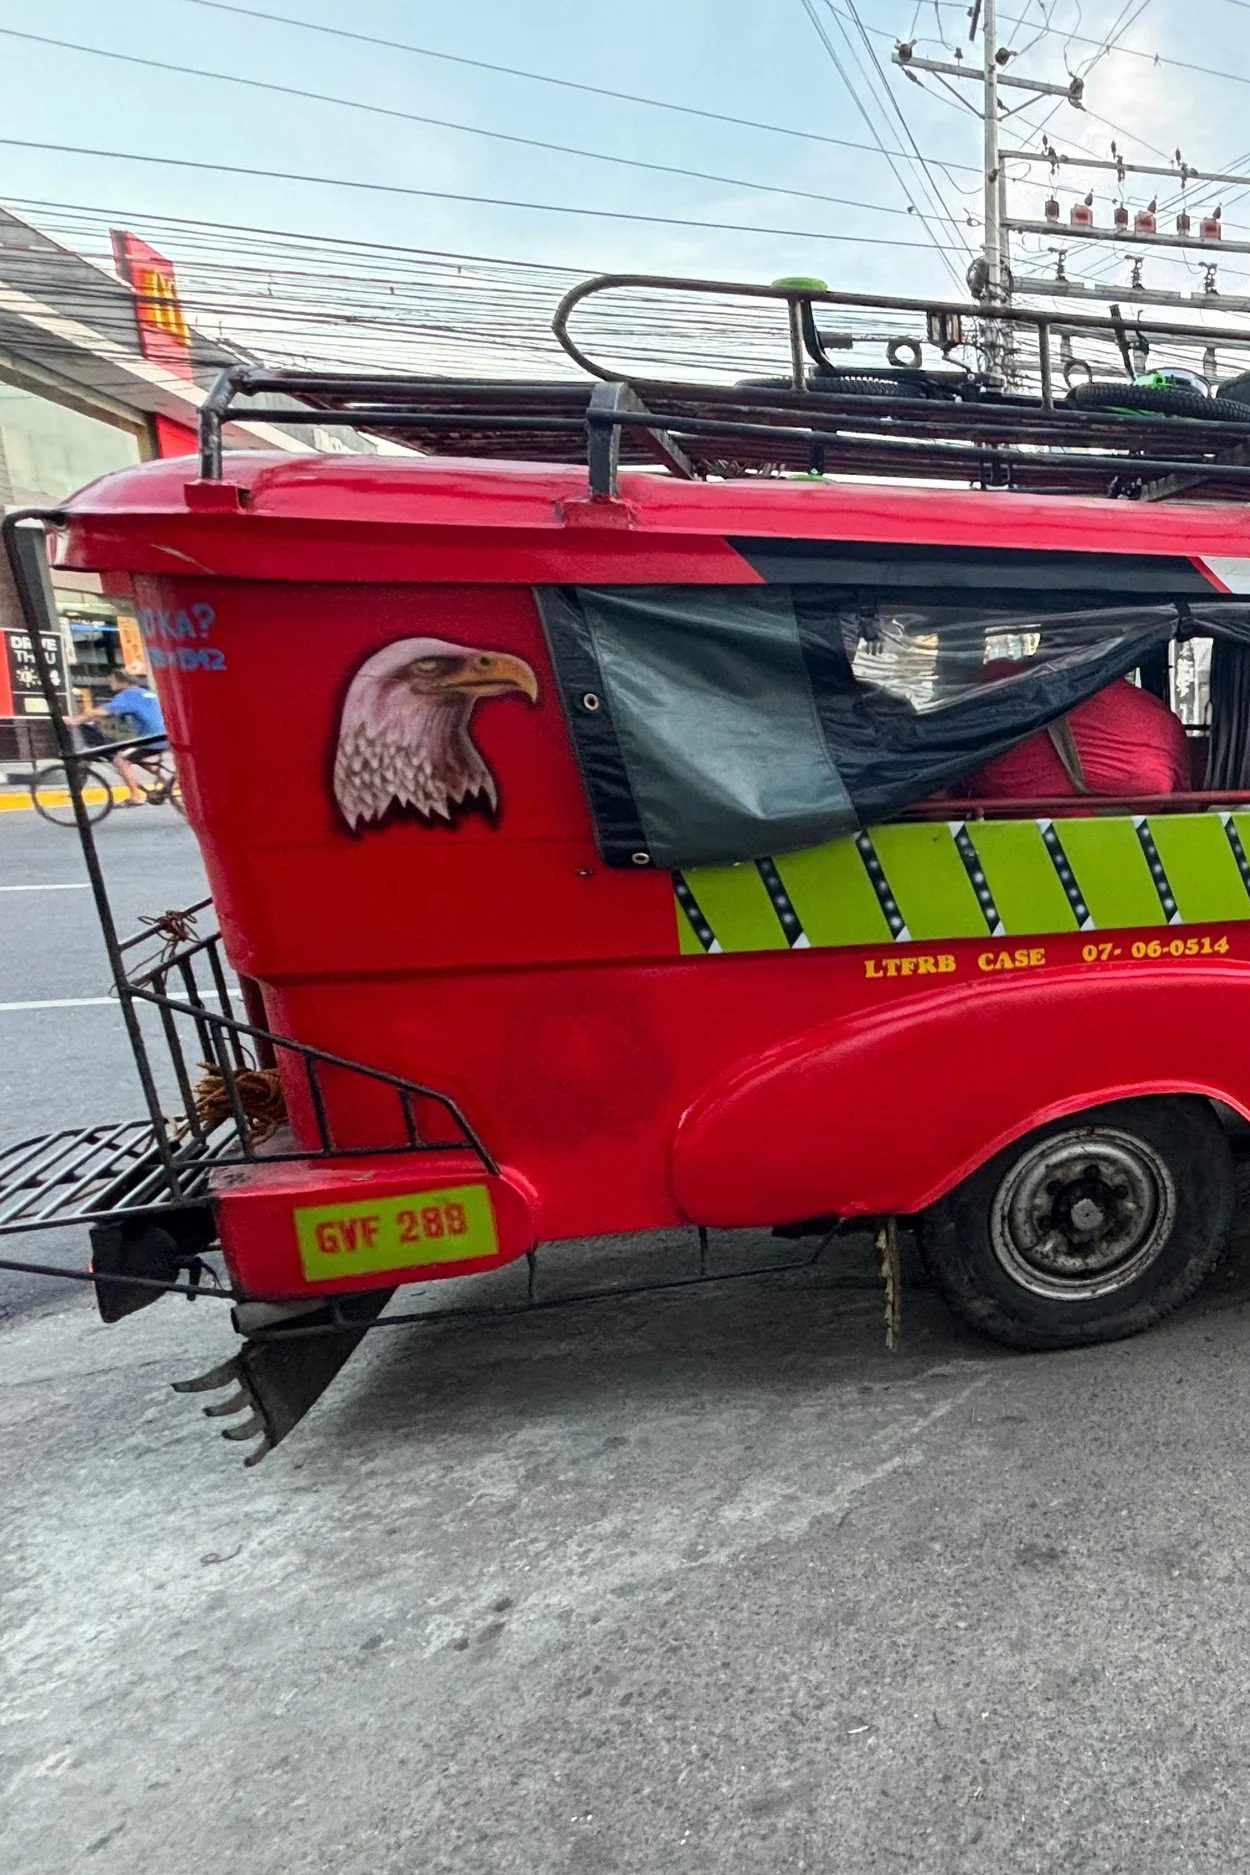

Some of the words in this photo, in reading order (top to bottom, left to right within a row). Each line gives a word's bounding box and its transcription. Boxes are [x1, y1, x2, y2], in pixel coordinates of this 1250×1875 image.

[10, 636, 57, 651] DRE
[14, 650, 56, 665] THU
[865, 954, 957, 978] LTFRB
[978, 948, 1046, 970] CASE
[1131, 936, 1229, 958] 06-0514
[315, 1215, 380, 1254] GVF
